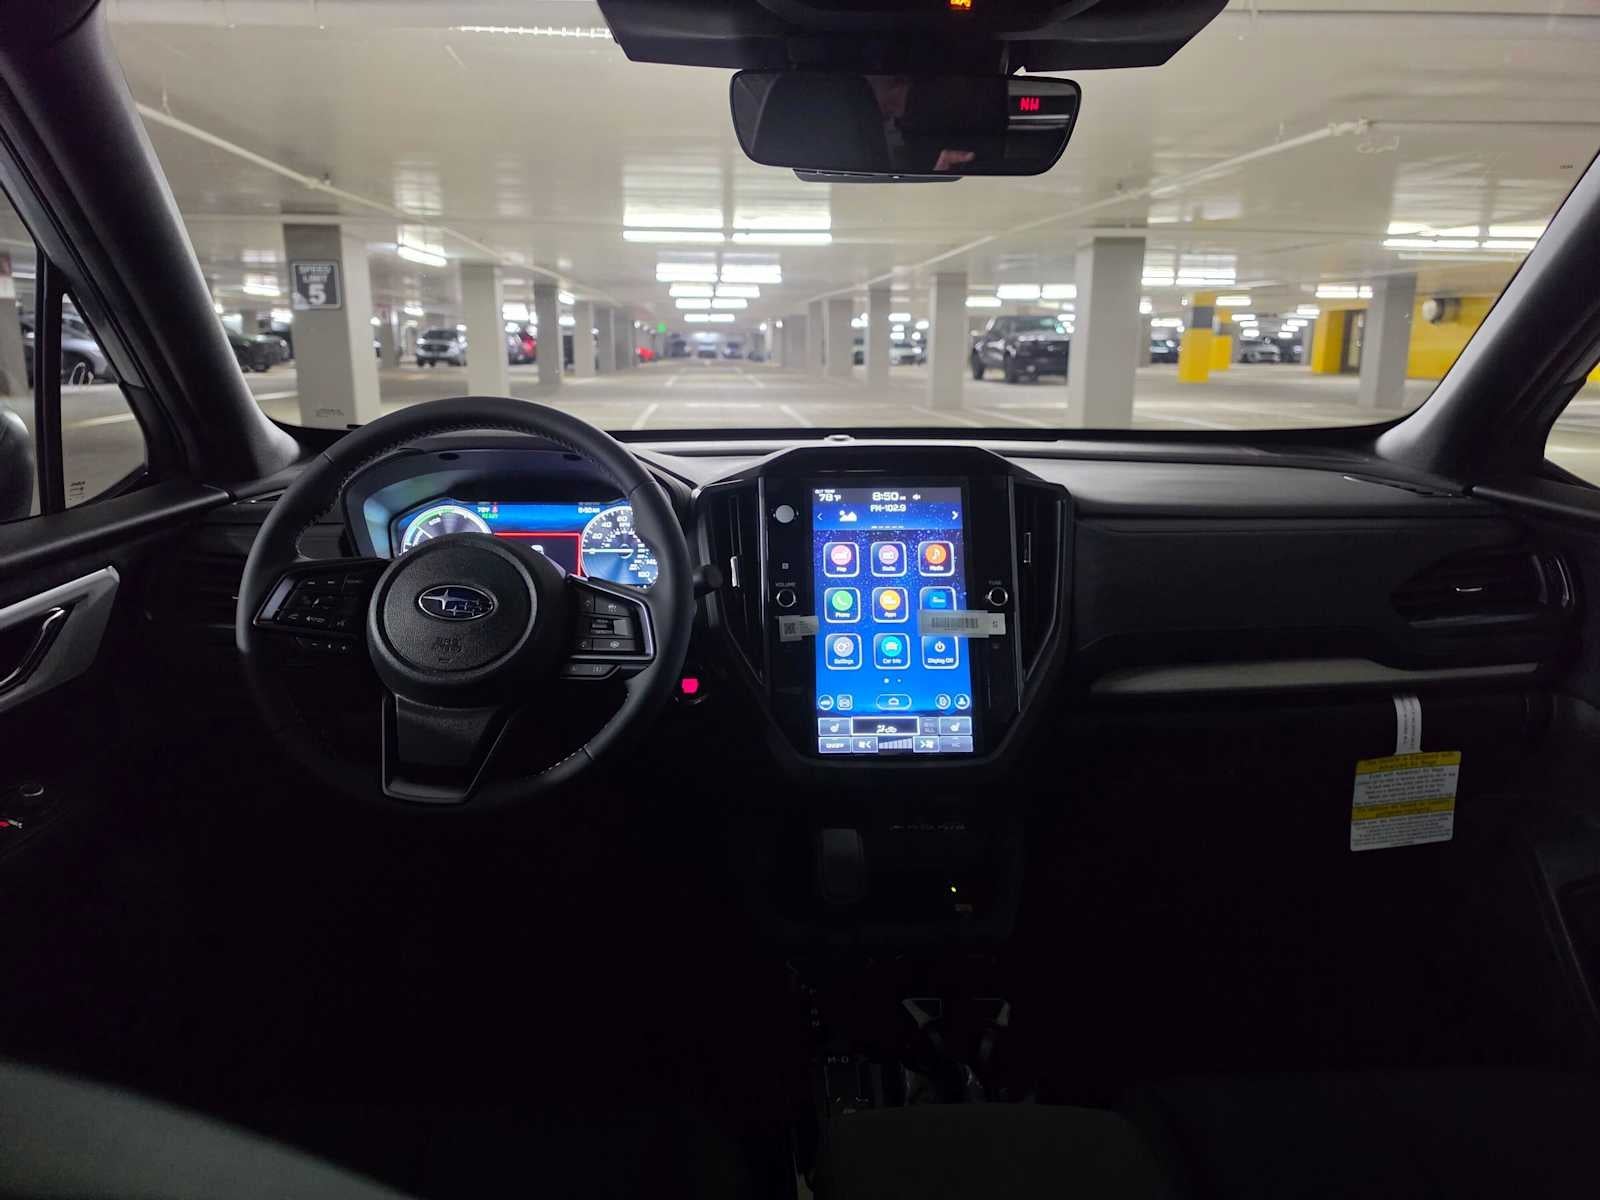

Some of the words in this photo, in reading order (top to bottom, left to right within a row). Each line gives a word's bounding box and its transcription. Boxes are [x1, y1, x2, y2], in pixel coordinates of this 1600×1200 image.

[1020, 97, 1040, 111] NW
[299, 264, 332, 273] SPEED
[309, 283, 327, 305] 5
[872, 491, 899, 501] 8:50
[870, 504, 906, 512] FM-102.9
